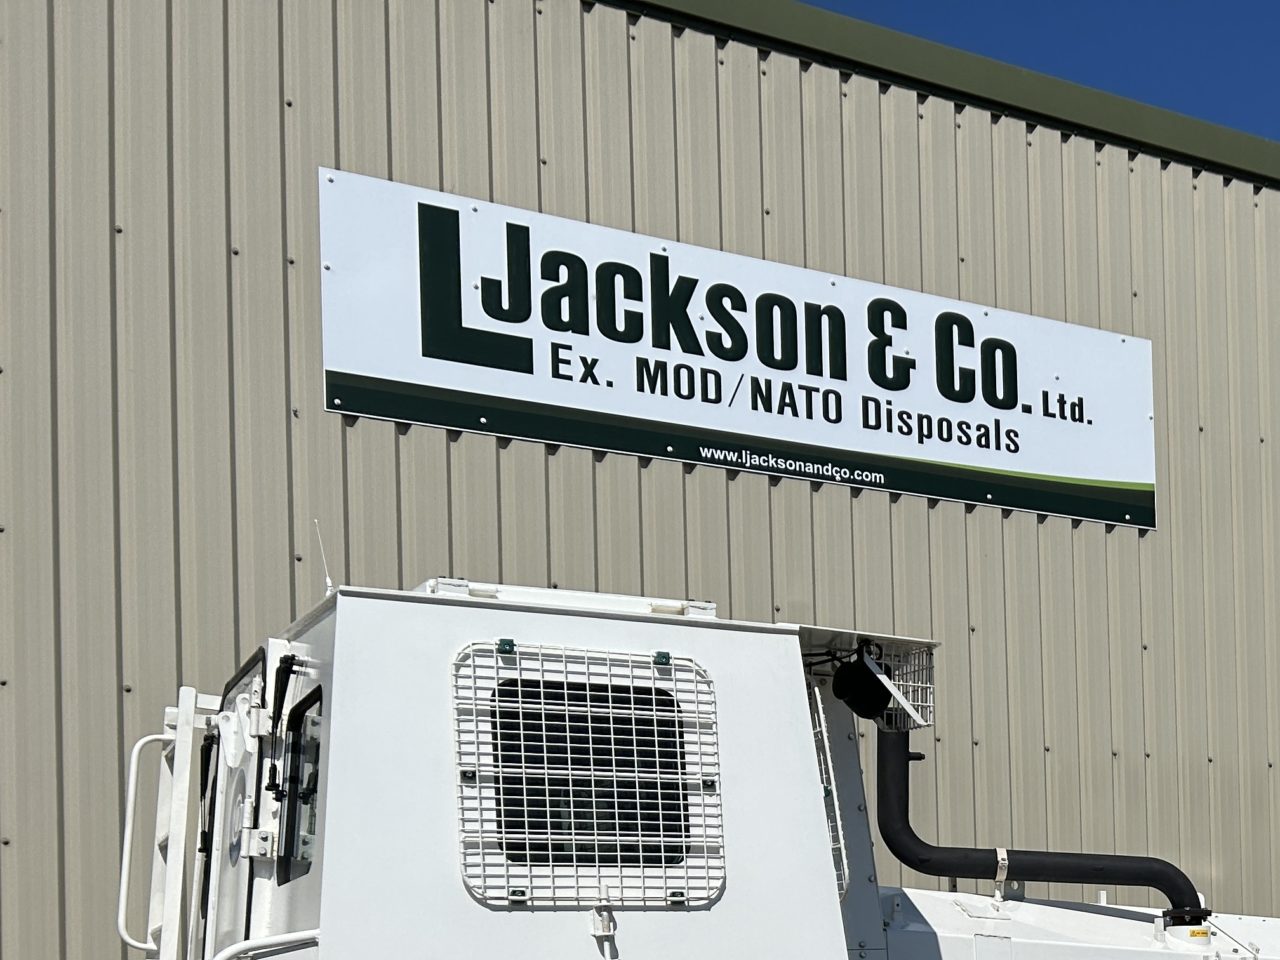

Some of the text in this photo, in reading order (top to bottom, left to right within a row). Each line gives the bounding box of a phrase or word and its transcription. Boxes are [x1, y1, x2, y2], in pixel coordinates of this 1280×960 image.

[551, 341, 1020, 454] Ex. MOD/NATO Disposals
[868, 298, 916, 391] &
[935, 311, 1033, 414] Co.
[1042, 390, 1093, 425] Ltd.
[699, 446, 885, 485] www.ljacksonandco.com
